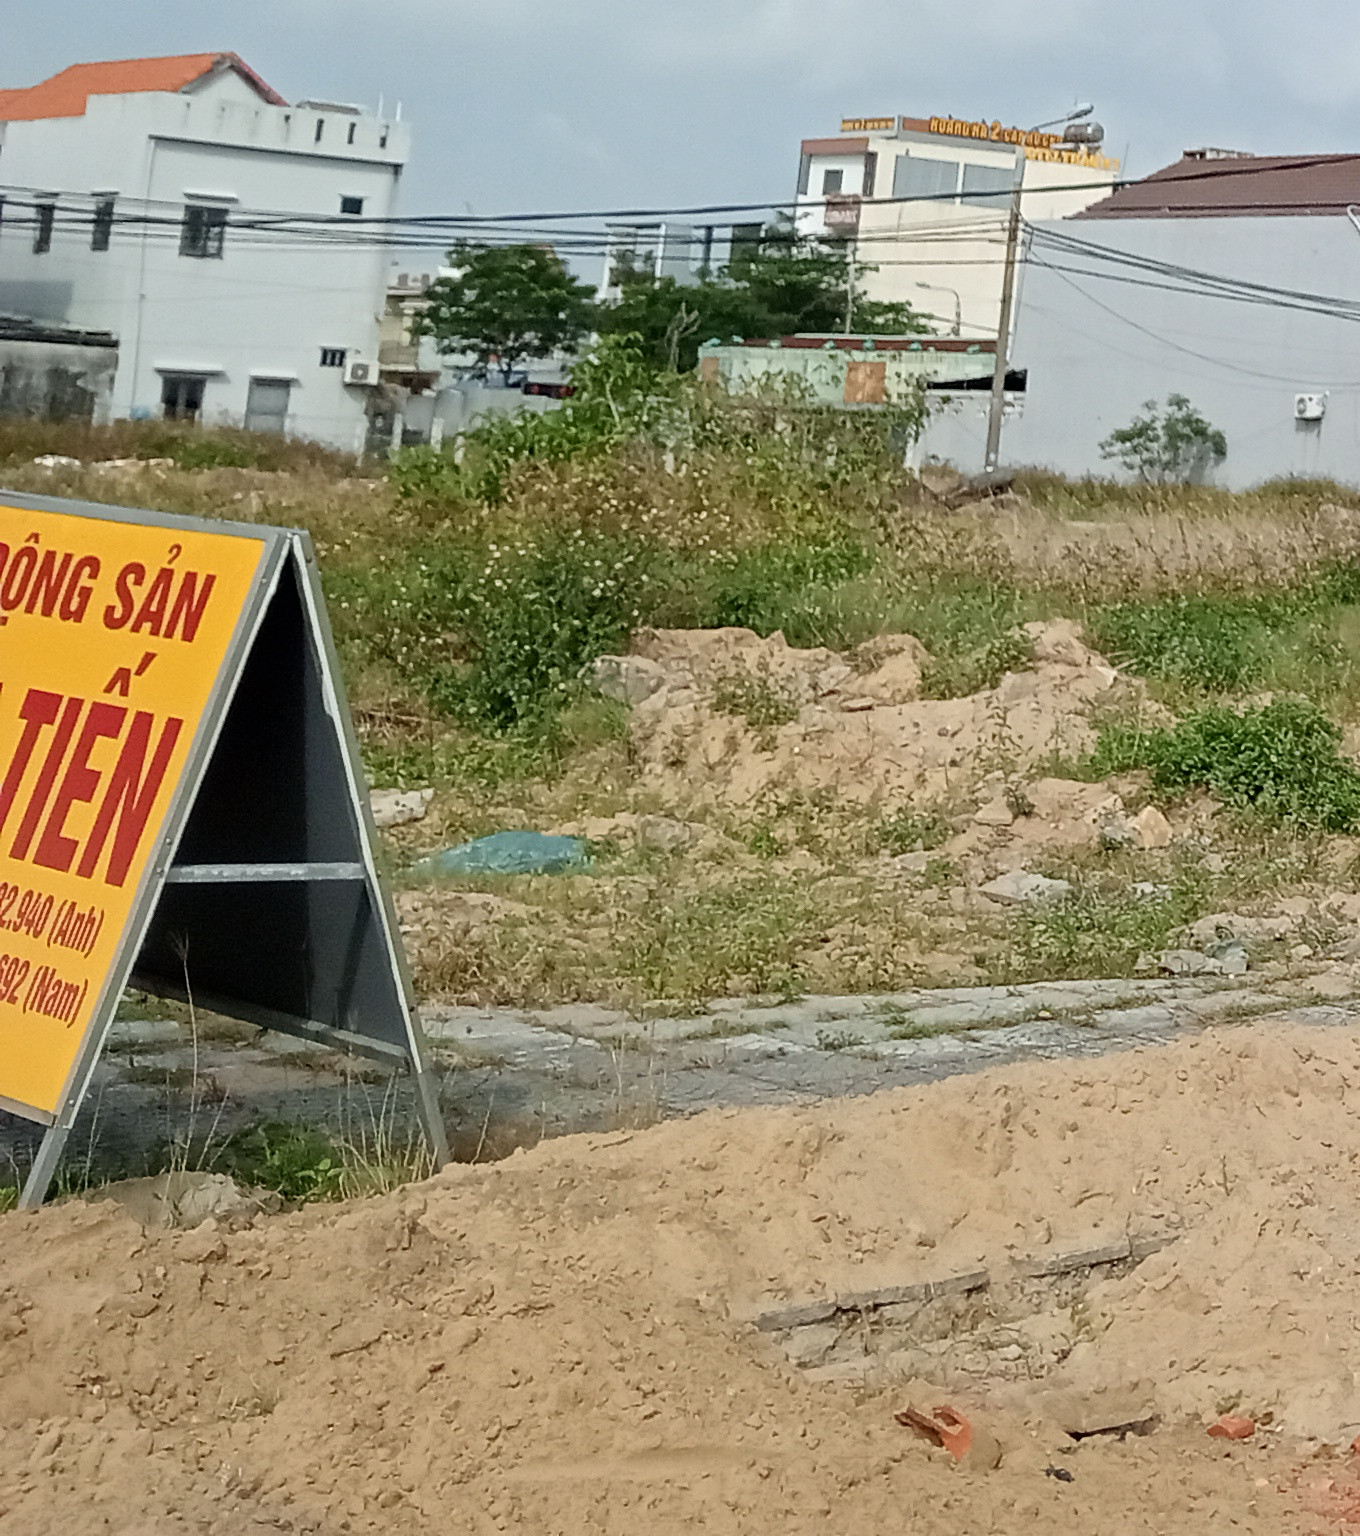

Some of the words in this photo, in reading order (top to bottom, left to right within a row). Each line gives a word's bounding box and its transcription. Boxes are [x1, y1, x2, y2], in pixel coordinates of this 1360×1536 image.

[990, 120, 1002, 142] 2
[103, 545, 216, 643] SẢN
[0, 652, 183, 889] TIẾN
[46, 899, 105, 959] (Anh)
[22, 965, 89, 1029] (Nam)
